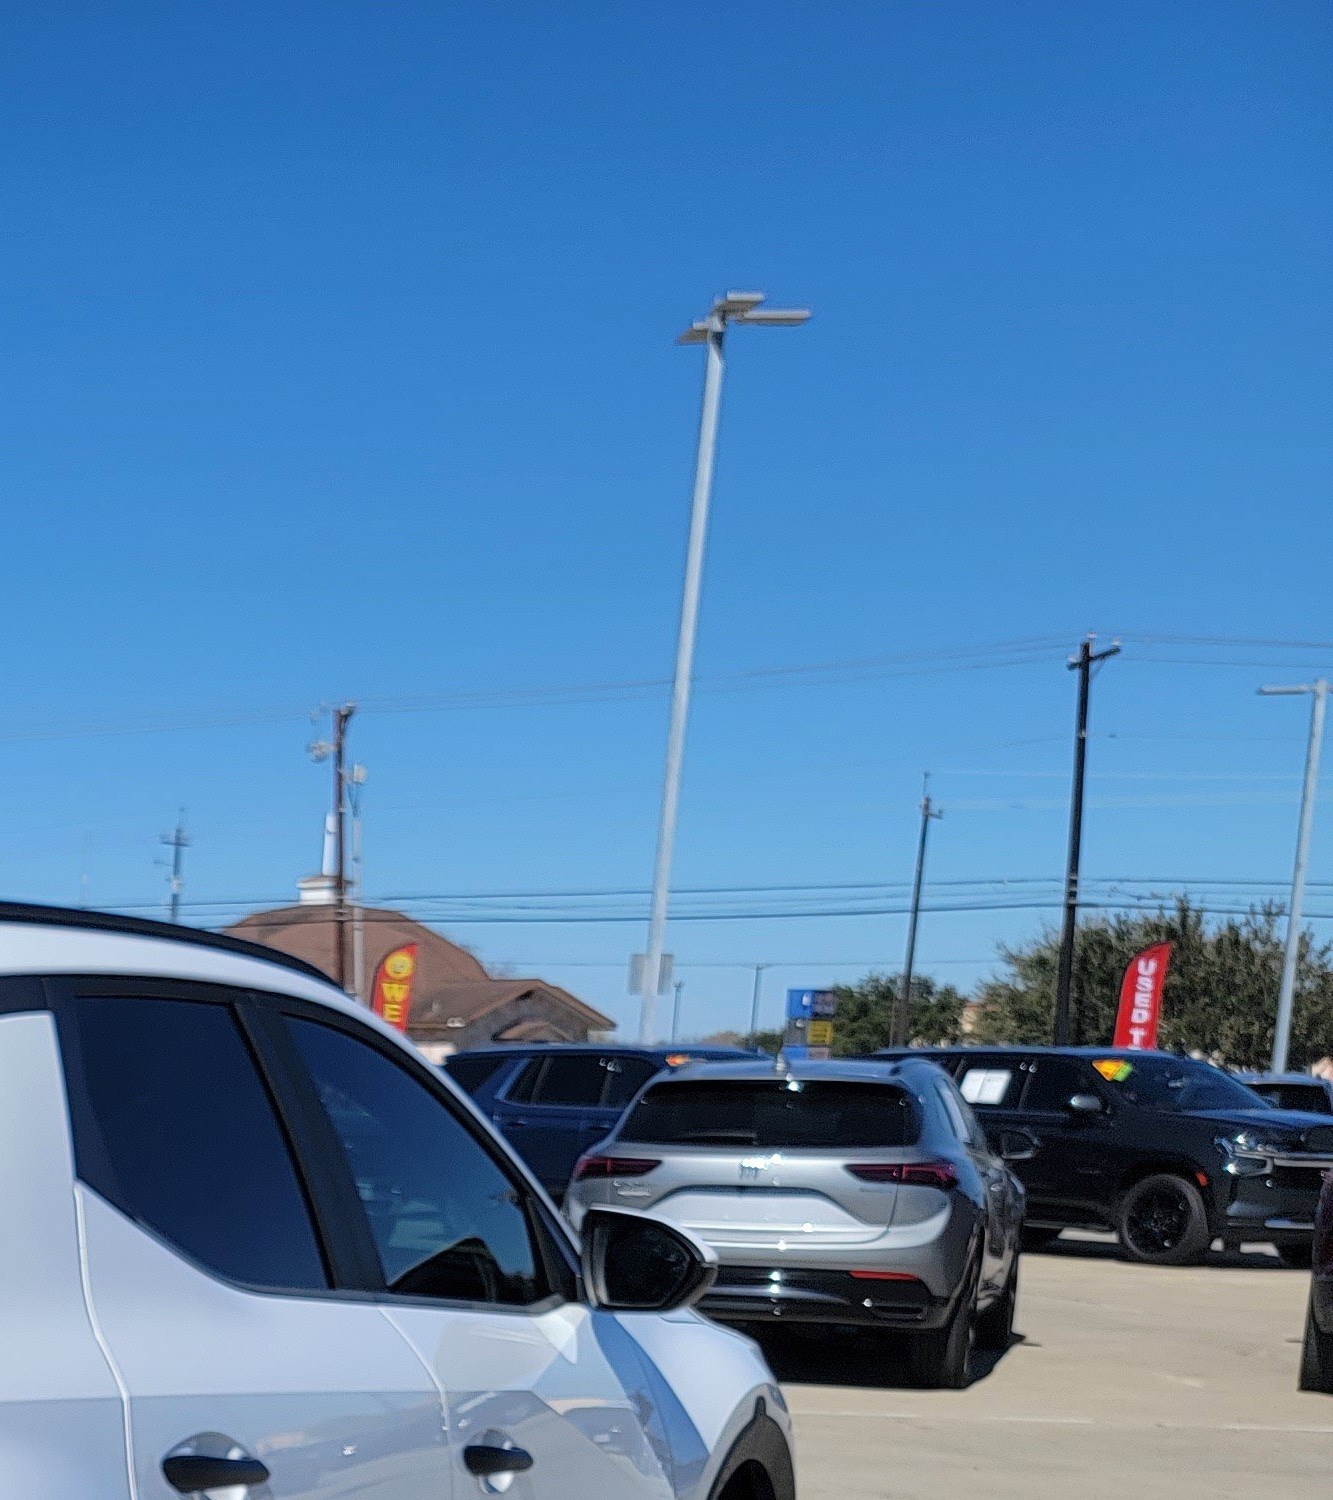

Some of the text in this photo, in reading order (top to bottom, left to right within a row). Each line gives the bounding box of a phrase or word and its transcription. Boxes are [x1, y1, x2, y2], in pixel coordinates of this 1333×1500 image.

[380, 983, 410, 1022] WE
[1127, 958, 1158, 1050] USED T
